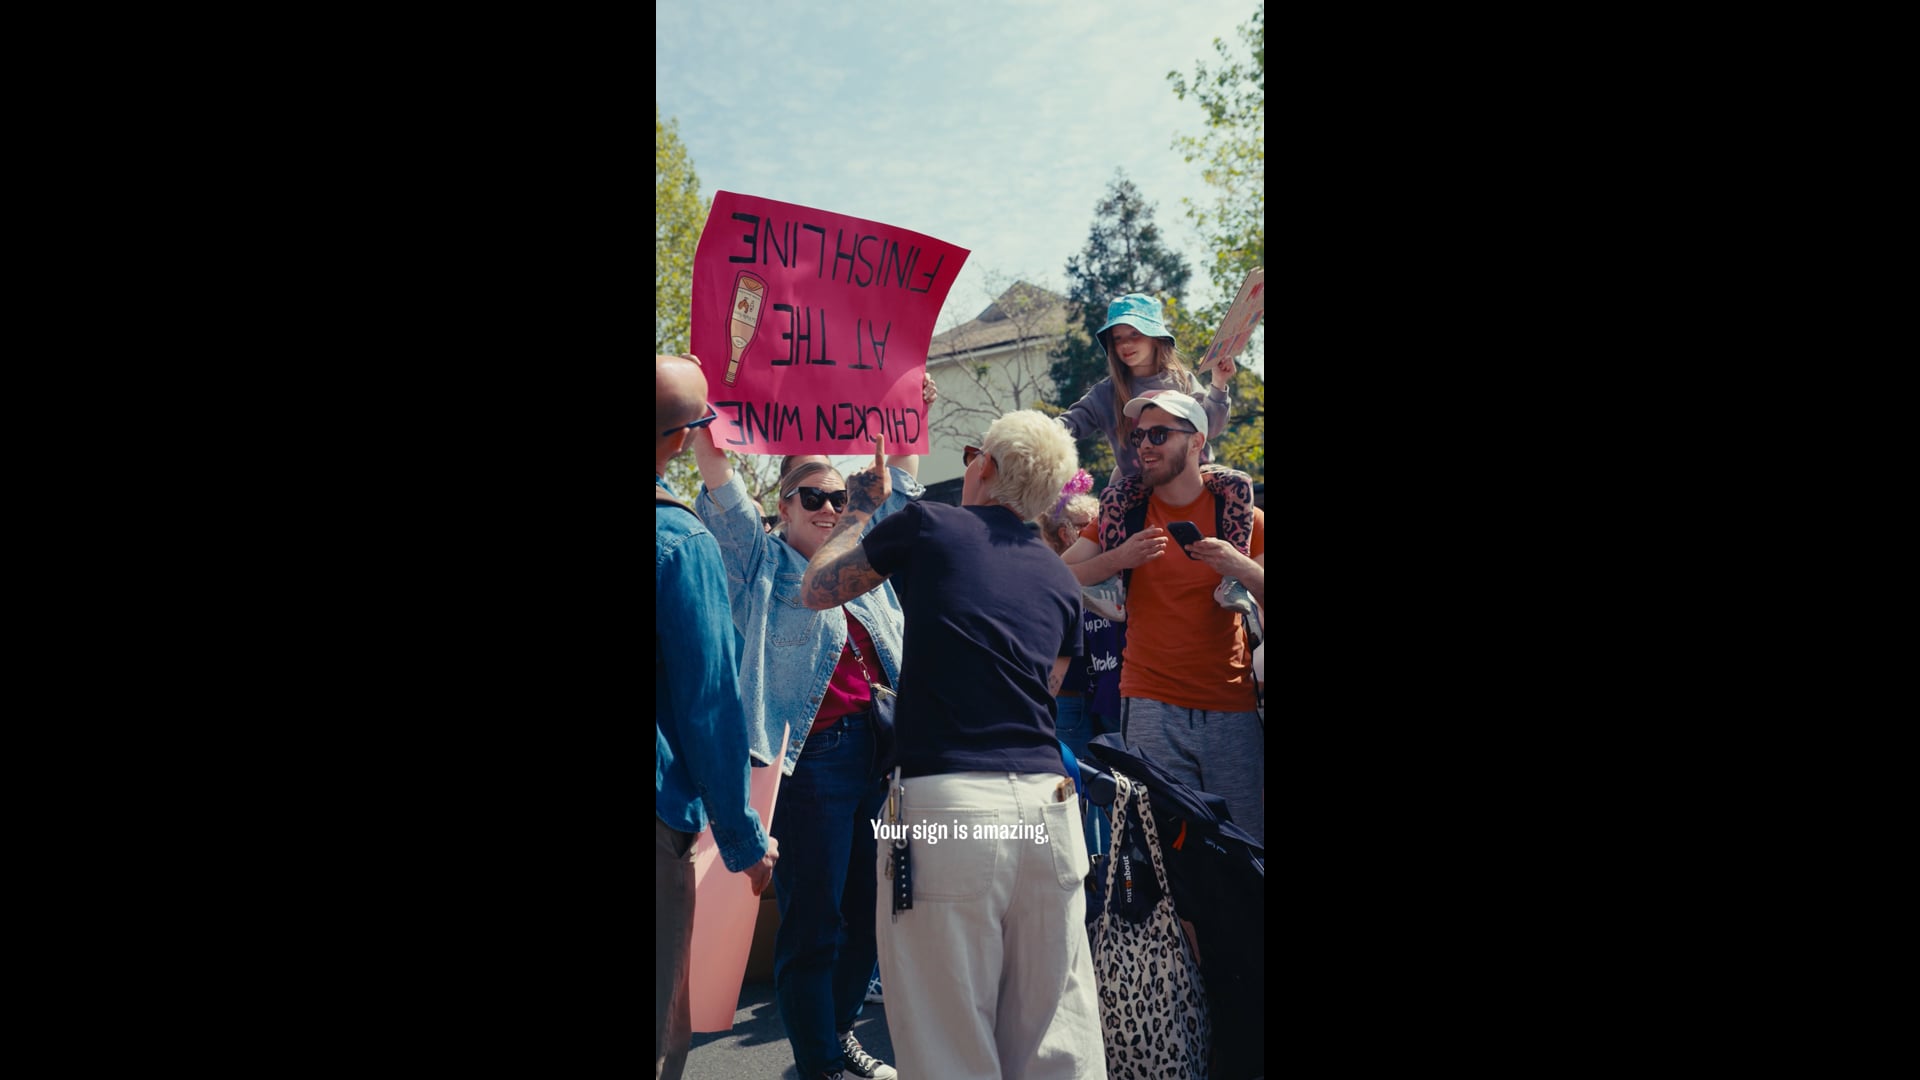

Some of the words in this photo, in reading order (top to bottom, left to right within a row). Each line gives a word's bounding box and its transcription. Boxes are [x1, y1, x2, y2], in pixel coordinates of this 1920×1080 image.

[728, 212, 826, 279] LINE
[832, 228, 945, 294] FINISH
[771, 303, 836, 366] THE
[848, 318, 892, 371] AT
[714, 401, 804, 445] WINE
[816, 402, 921, 444] CHICKEN
